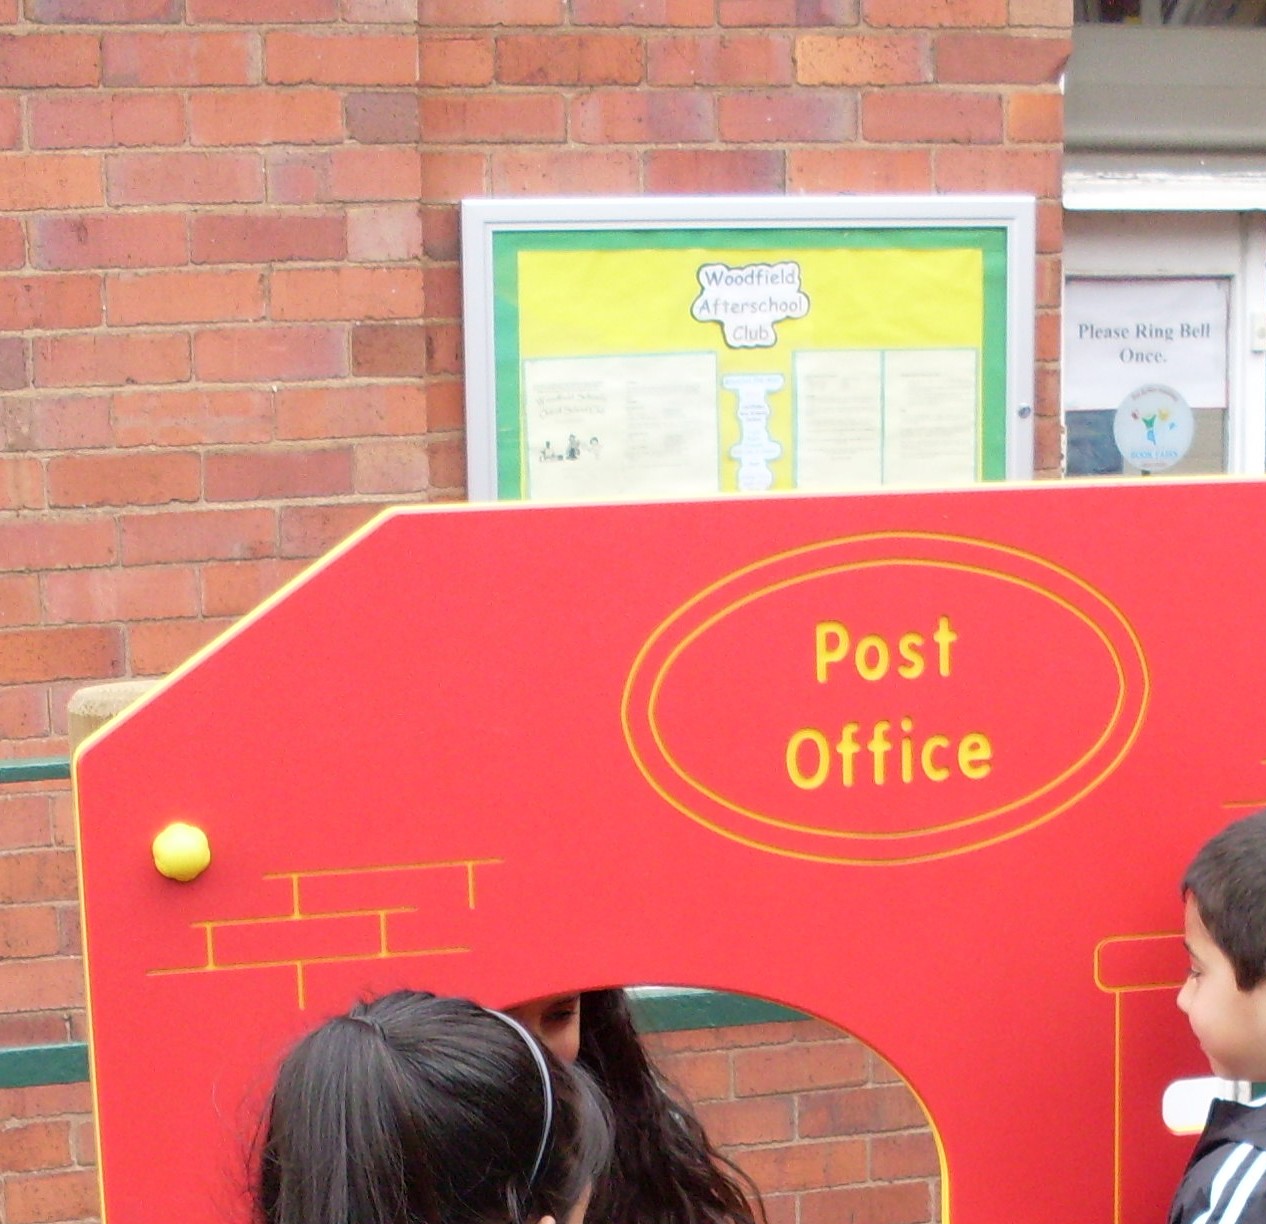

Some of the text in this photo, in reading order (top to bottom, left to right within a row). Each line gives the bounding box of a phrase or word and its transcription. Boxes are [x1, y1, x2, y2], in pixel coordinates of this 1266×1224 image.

[704, 268, 796, 287] Woodfield
[698, 295, 803, 316] Afterschool
[732, 324, 769, 341] Club
[1078, 322, 1211, 341] Please Ring Bell
[1119, 348, 1168, 364] Once.
[815, 614, 958, 684] Post
[785, 716, 992, 791] Office
